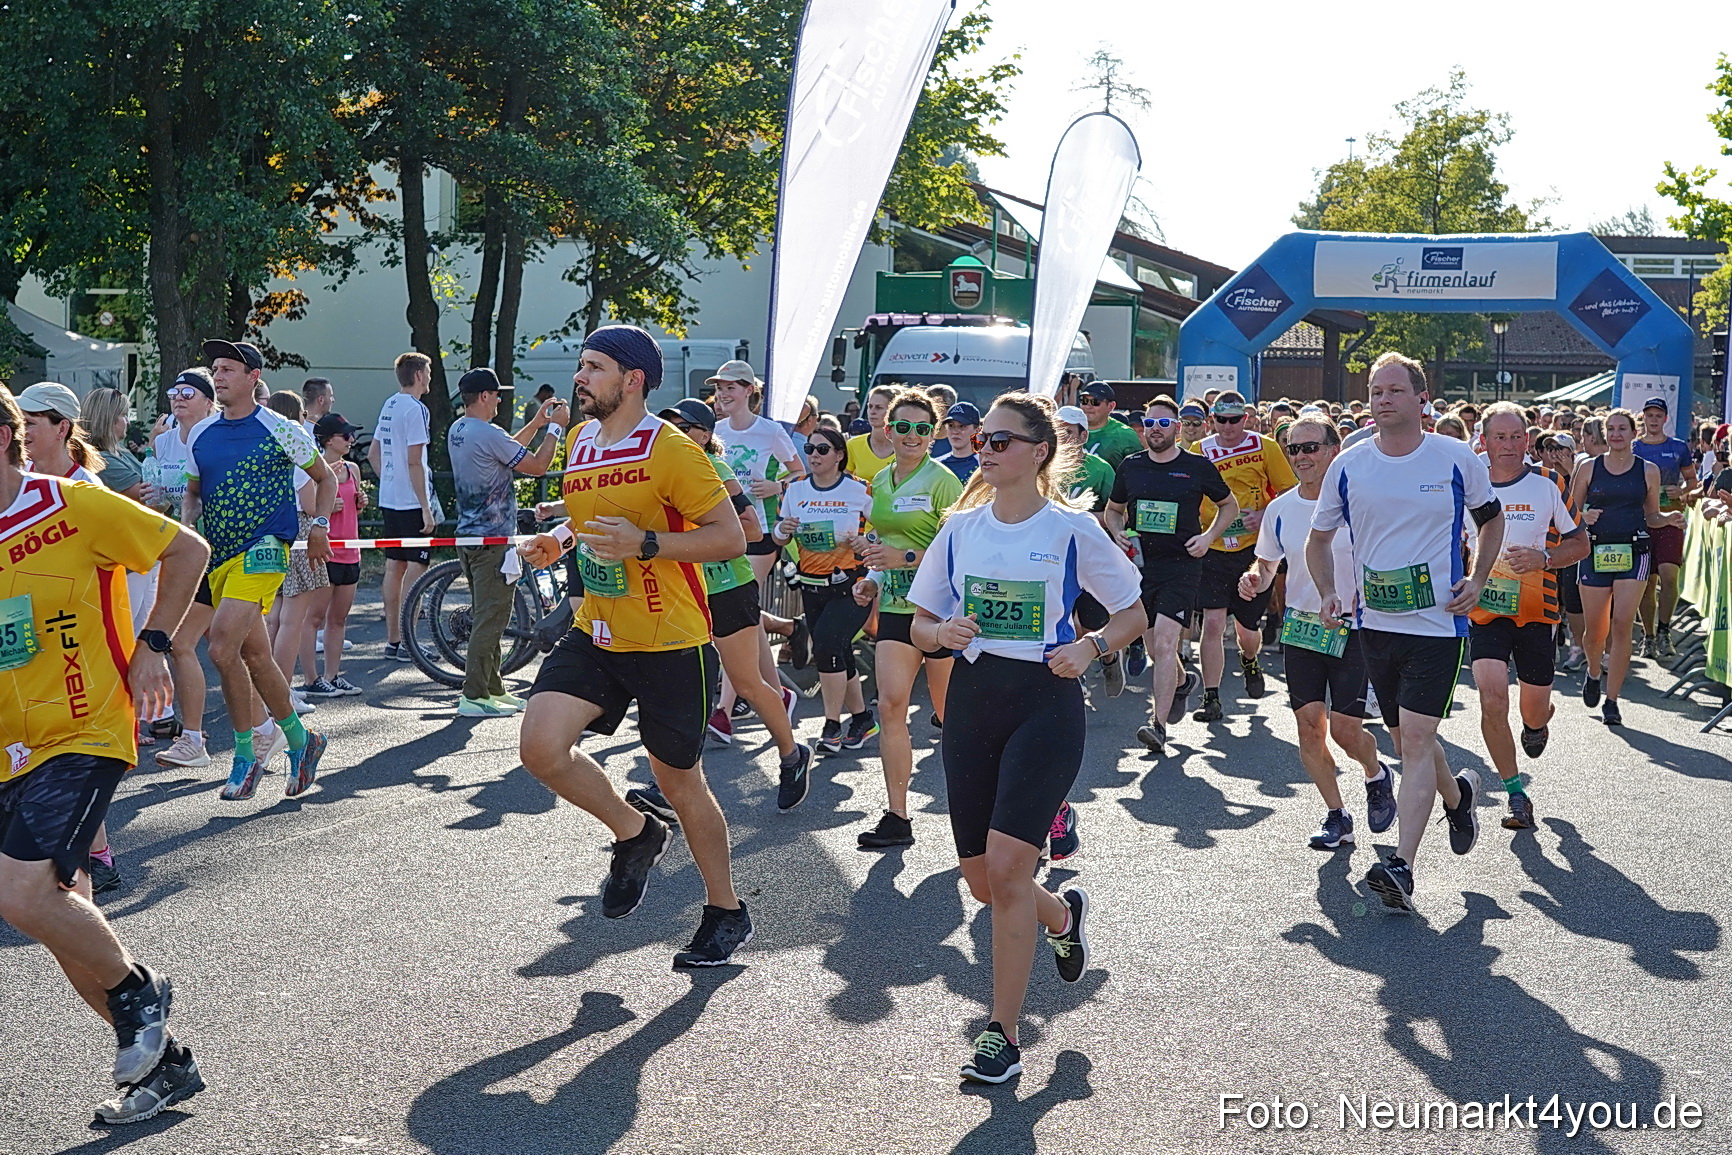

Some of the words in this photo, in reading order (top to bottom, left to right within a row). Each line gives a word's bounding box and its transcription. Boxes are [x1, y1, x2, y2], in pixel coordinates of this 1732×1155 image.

[1407, 271, 1498, 287] firmenlauf
[1234, 295, 1282, 308] Fischer
[1238, 306, 1278, 314] AUTOMOBILE
[889, 353, 929, 361] abavent
[1218, 461, 1233, 472] AX
[1236, 454, 1264, 467] BÖGL
[564, 477, 593, 496] MAX
[597, 468, 650, 488] BÖGL
[1504, 503, 1535, 512] EBL
[1145, 511, 1167, 523] 775
[1505, 513, 1535, 521] AMICS
[8, 519, 79, 565] BÖGL
[804, 532, 824, 543] 364
[256, 548, 279, 561] 687
[420, 551, 428, 560] 26
[1604, 554, 1623, 563] 487
[585, 559, 607, 581] 805
[614, 566, 625, 591] 2022
[639, 562, 664, 613] max
[1371, 584, 1398, 599] 319
[1404, 584, 1414, 605] 2022
[1483, 588, 1506, 604] 404
[967, 602, 975, 617] UN
[982, 599, 1024, 621] 325
[1004, 621, 1032, 630] Juliane
[1032, 606, 1041, 633] 2022
[0, 622, 18, 646] 5
[1295, 620, 1320, 637] 315
[23, 622, 37, 654] 2022
